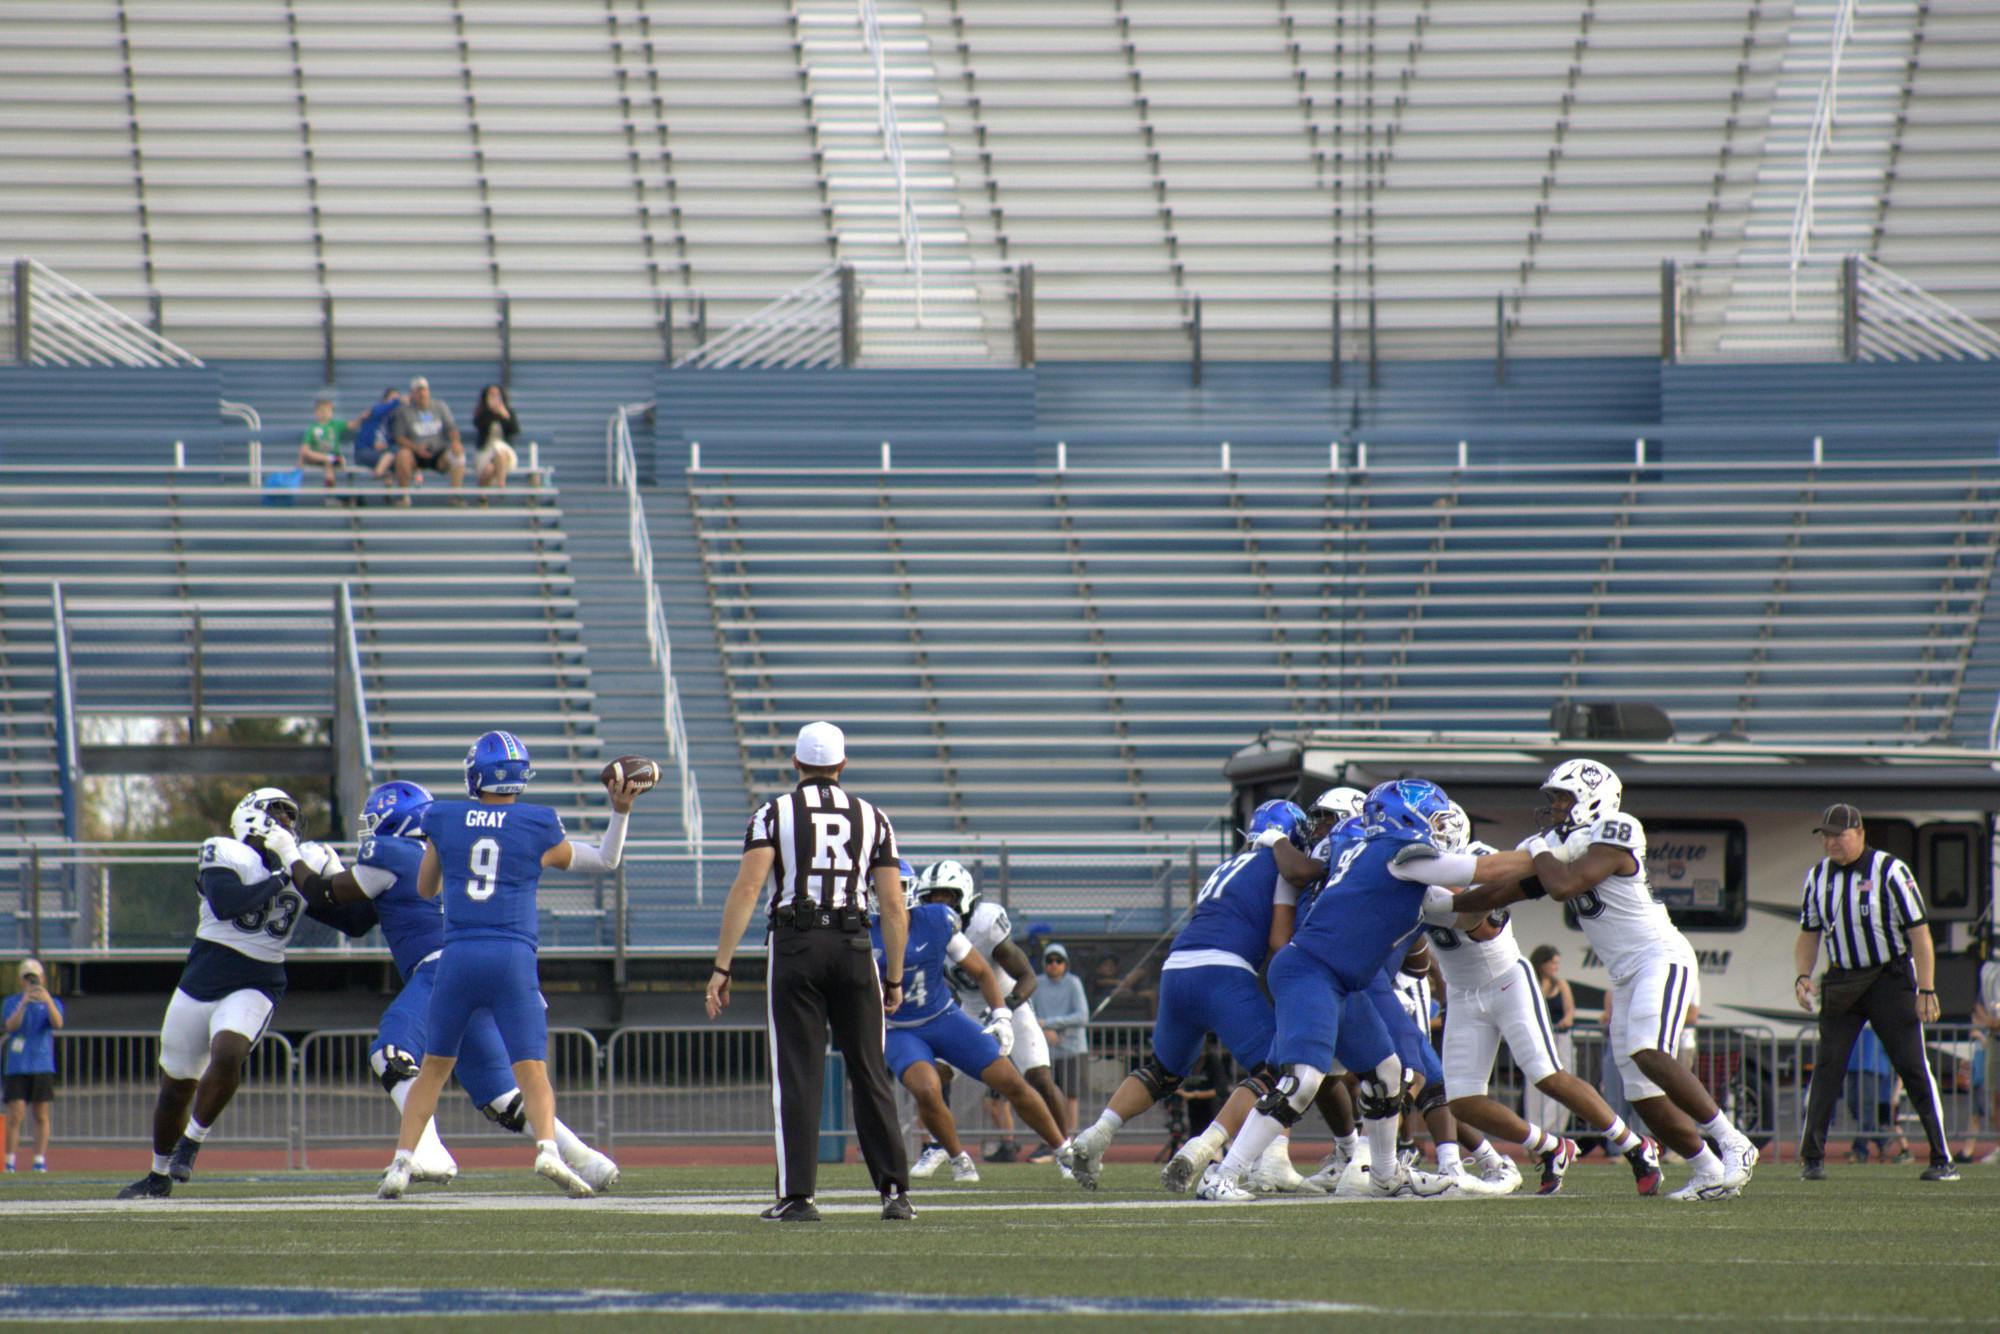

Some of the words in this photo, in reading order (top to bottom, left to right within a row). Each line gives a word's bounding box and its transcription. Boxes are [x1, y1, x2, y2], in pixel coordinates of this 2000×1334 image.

[466, 810, 507, 828] GRAY
[811, 812, 853, 871] R
[1602, 820, 1632, 842] 58
[467, 838, 500, 901] 9
[1197, 852, 1257, 904] 67
[821, 914, 831, 926] S
[1861, 905, 1870, 917] U
